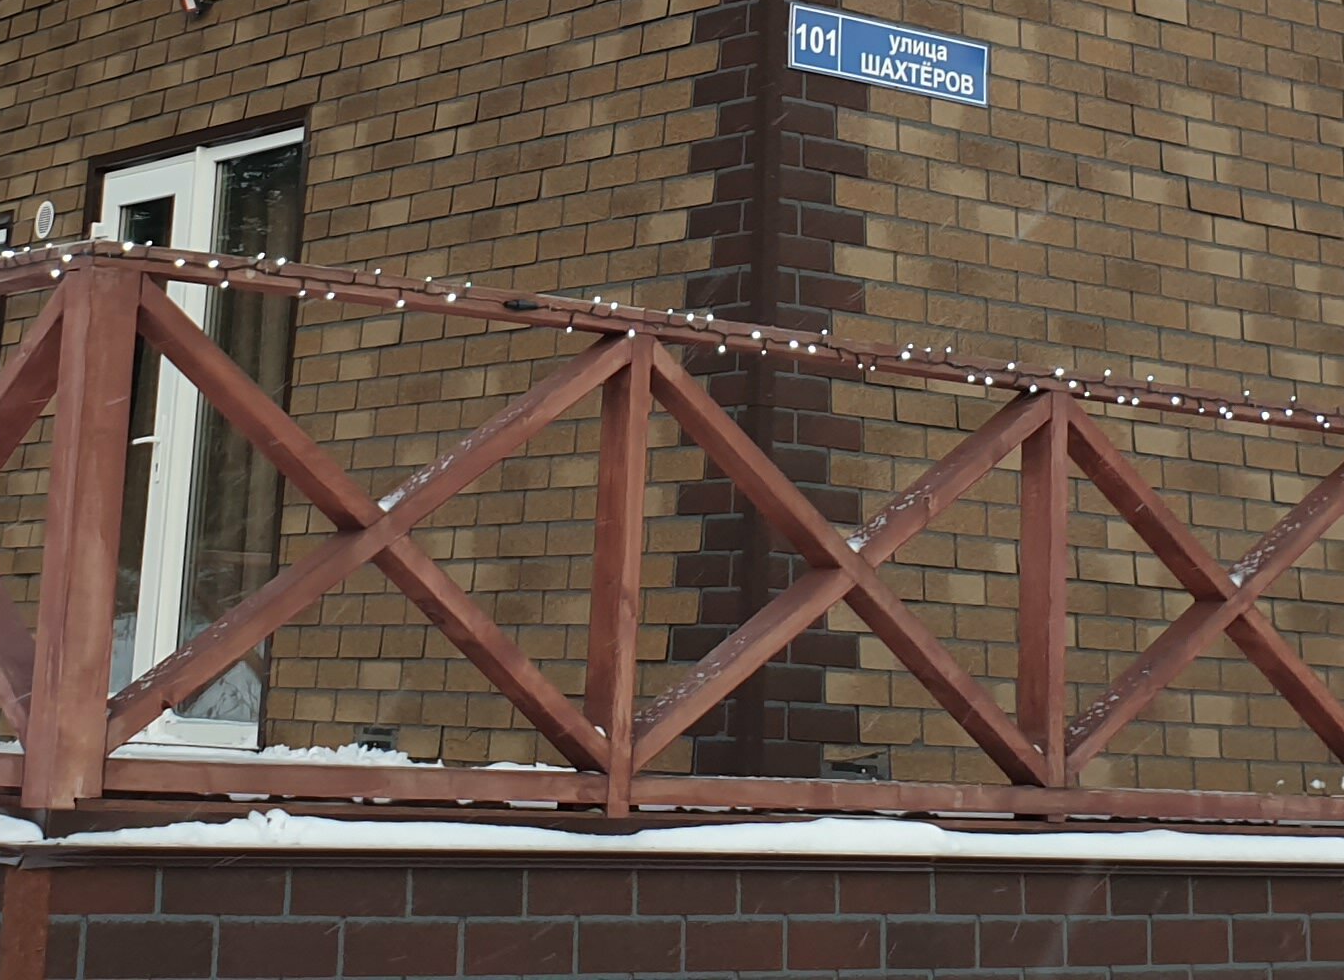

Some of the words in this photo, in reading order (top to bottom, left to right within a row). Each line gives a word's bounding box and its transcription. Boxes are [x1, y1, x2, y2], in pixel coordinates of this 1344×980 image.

[796, 23, 836, 56] 101
[889, 34, 948, 62] улица
[860, 52, 974, 95] ШАХТЁРОВ
